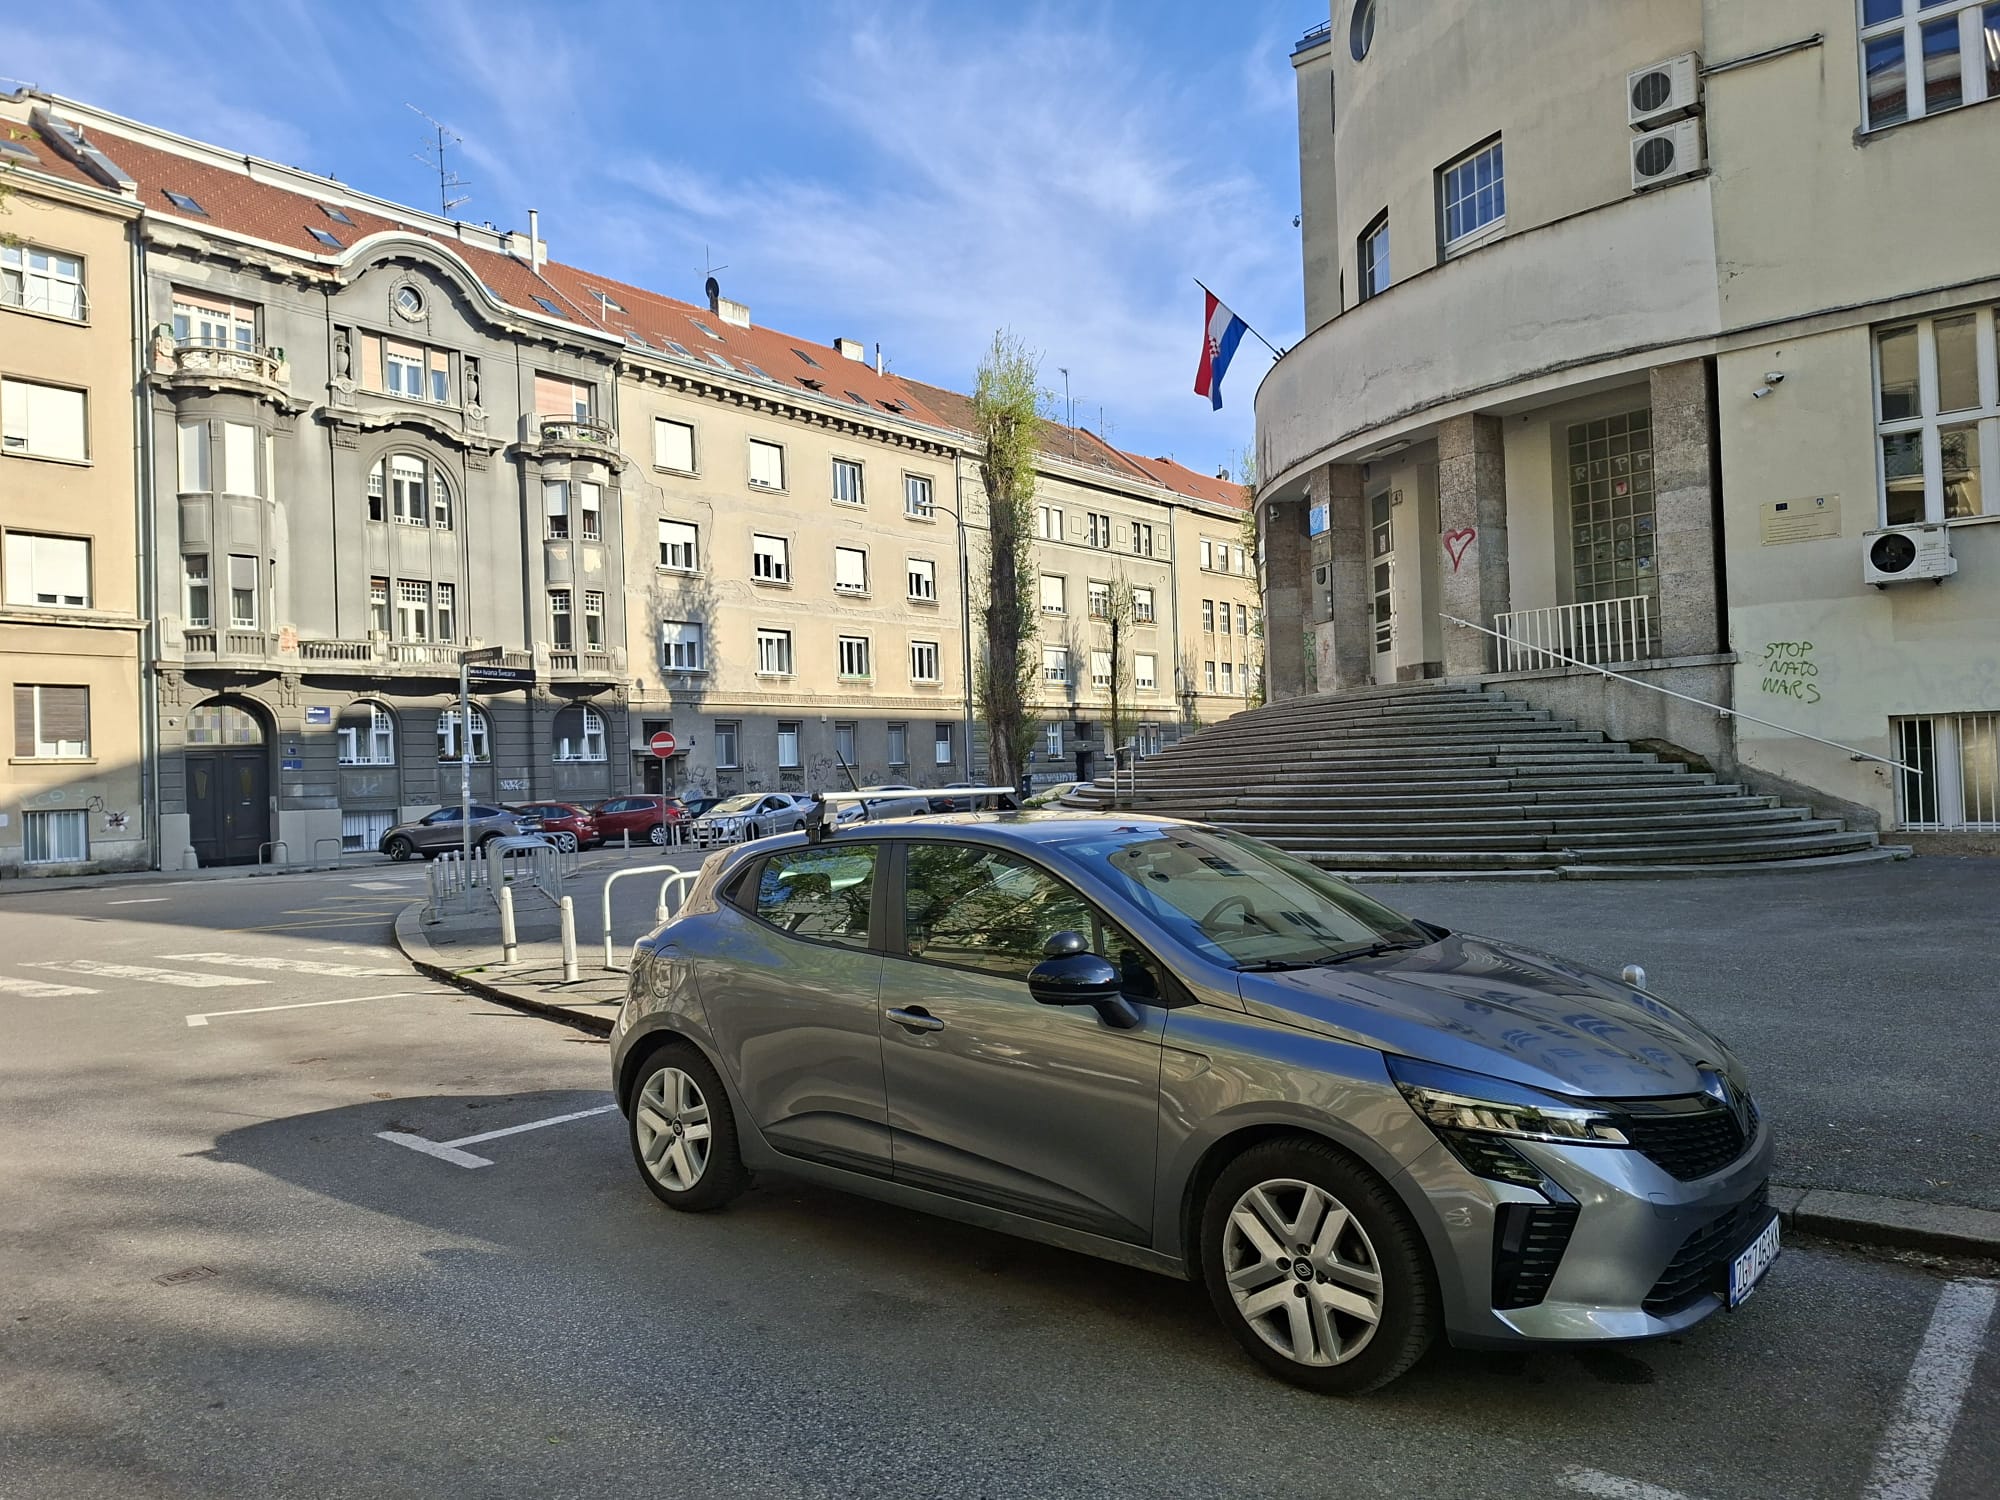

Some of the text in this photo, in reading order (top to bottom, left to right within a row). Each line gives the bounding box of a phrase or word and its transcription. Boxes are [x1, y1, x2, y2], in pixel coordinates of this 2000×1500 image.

[1764, 641, 1814, 659] STOP
[1770, 660, 1818, 676] NATO
[1762, 677, 1821, 704] WARS
[1736, 1255, 1748, 1294] ZG
